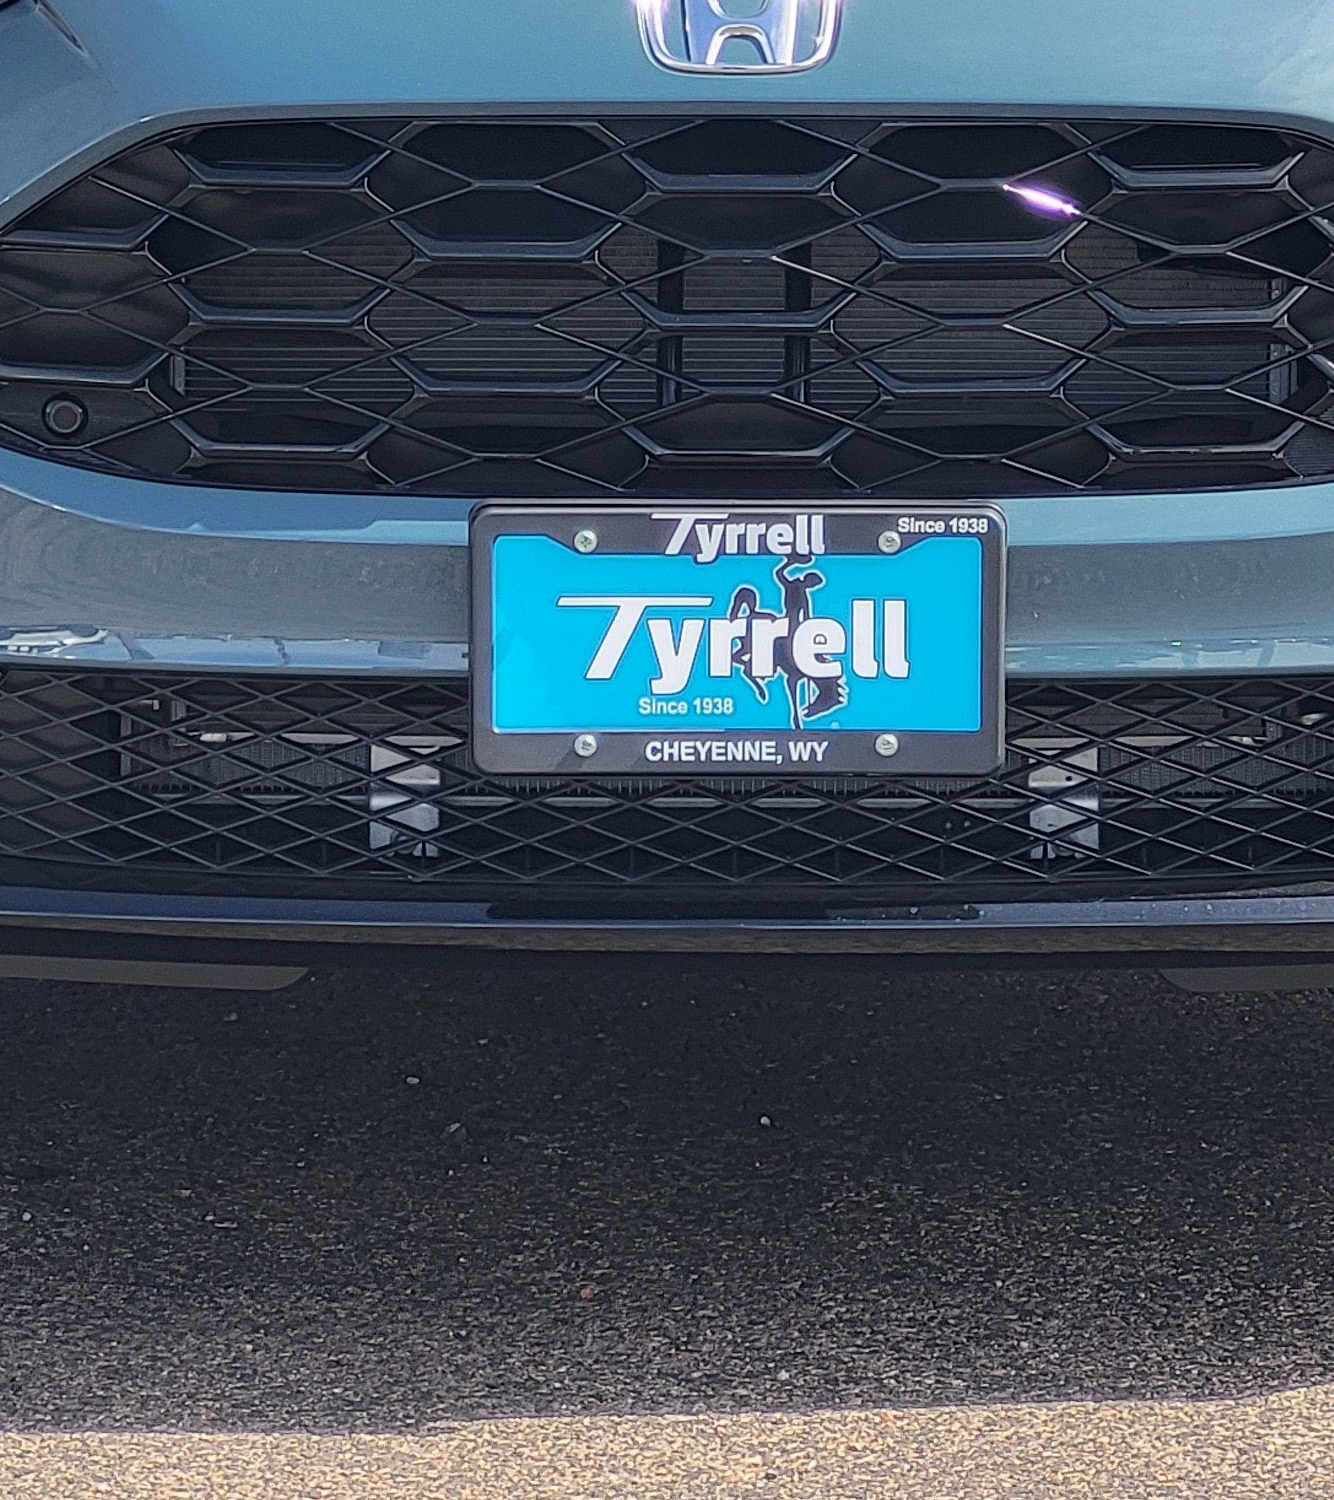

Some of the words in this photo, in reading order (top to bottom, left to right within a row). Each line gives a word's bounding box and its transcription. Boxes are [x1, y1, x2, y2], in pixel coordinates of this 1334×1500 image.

[651, 512, 826, 564] Tyrrell
[897, 516, 945, 534] Since
[950, 517, 989, 535] 1938
[556, 596, 912, 696] Tyrrell
[638, 697, 688, 715] Since
[692, 697, 734, 715] 1938
[645, 740, 783, 765] CHEYENNE,
[788, 741, 829, 762] WY
